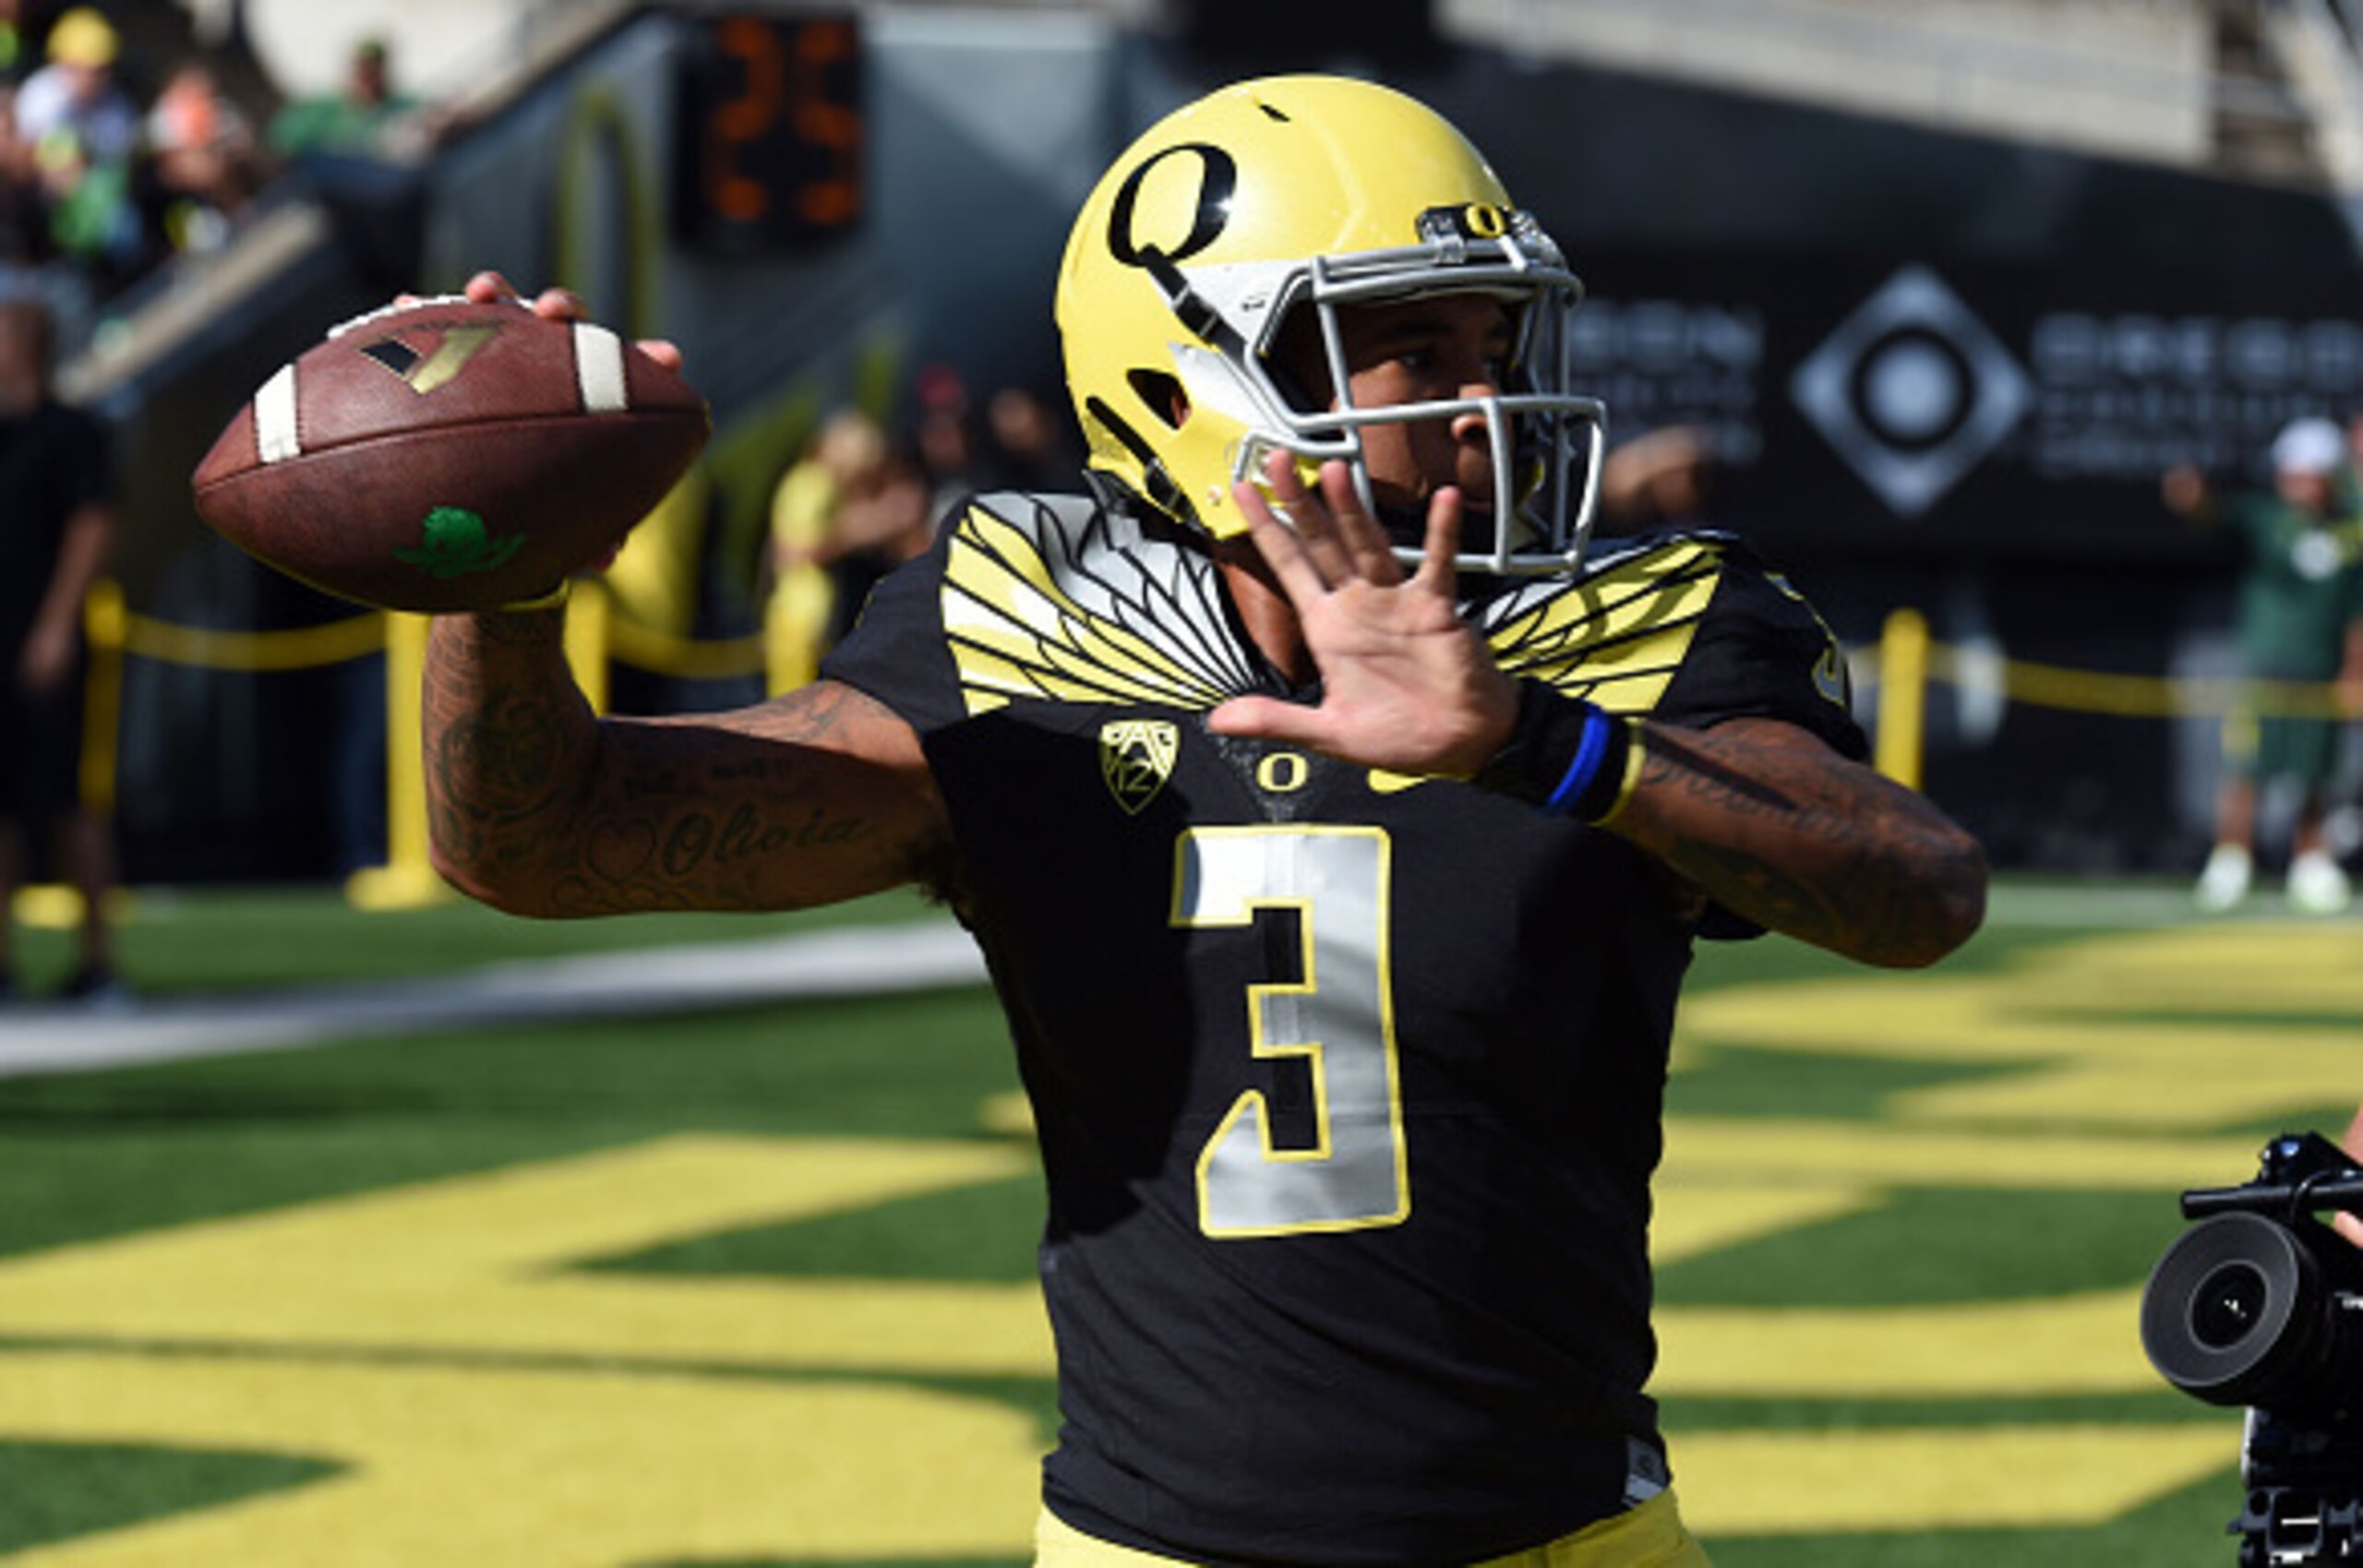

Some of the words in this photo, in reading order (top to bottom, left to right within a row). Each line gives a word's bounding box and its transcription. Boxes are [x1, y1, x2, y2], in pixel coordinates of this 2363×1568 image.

[705, 17, 866, 225] 25
[1465, 204, 1505, 238] O
[1256, 752, 1309, 792] O
[663, 800, 872, 876] Olivia
[1169, 822, 1411, 1239] 3
